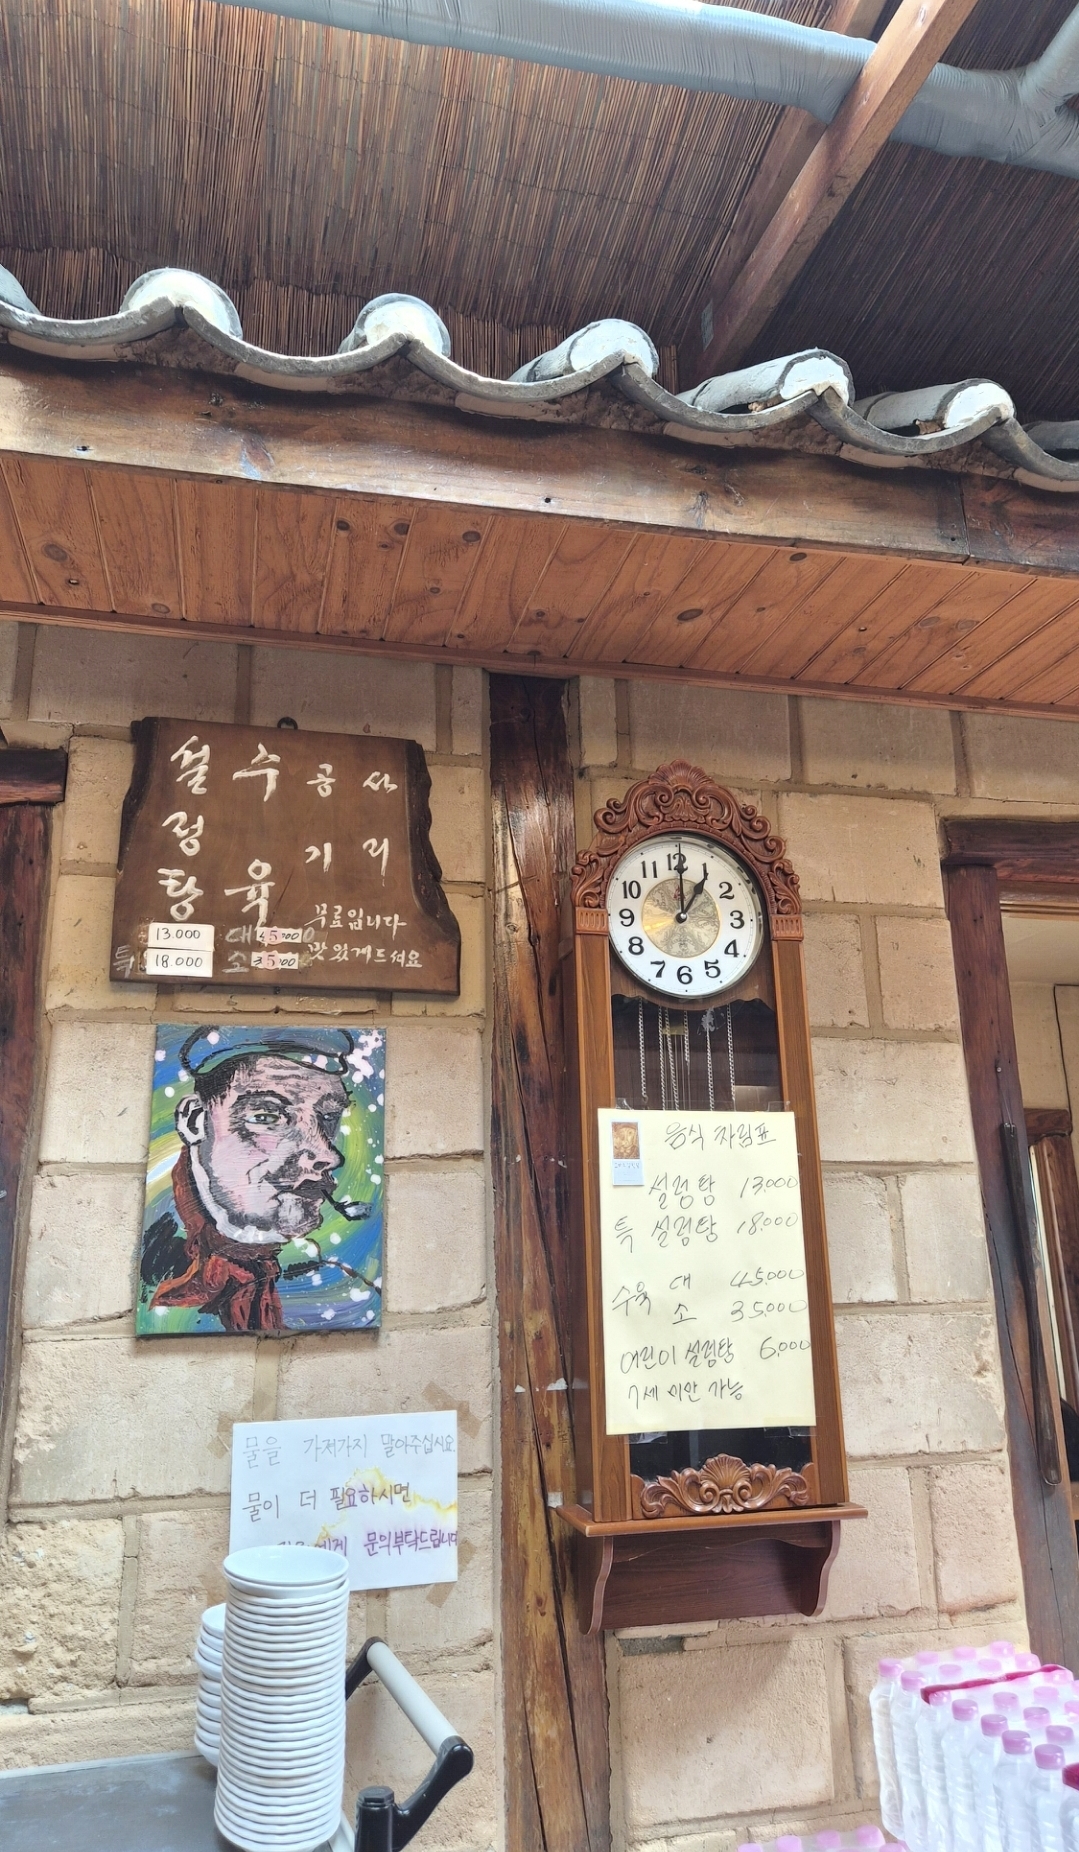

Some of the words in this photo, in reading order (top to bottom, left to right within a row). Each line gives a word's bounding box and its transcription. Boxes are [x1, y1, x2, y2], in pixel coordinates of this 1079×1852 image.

[305, 763, 336, 873] 공기
[224, 742, 282, 931] 수육
[641, 861, 658, 878] 11
[667, 853, 688, 871] 12
[622, 880, 641, 899] 10
[719, 882, 735, 900] 2
[619, 908, 634, 927] 9
[730, 910, 745, 929] 3
[156, 928, 201, 940] 13.000
[628, 936, 644, 955] 8
[724, 939, 739, 958] 4
[155, 954, 203, 968] 18.000
[650, 960, 666, 978] 7
[704, 959, 721, 978] 5
[677, 966, 693, 985] 6
[664, 1121, 704, 1151] 음식
[649, 1172, 715, 1210] 설렁탕
[614, 1216, 633, 1253] 특
[651, 1215, 718, 1248] 설렁탕
[669, 1273, 691, 1290] 대
[672, 1303, 697, 1325] 소
[620, 1345, 677, 1374] 어린이
[708, 1377, 744, 1401] 가능
[243, 1436, 281, 1469] 물을
[303, 1434, 367, 1463] 가져가지
[242, 1491, 280, 1523] 물이
[300, 1489, 317, 1510] 더
[330, 1482, 411, 1511] 필요하시면
